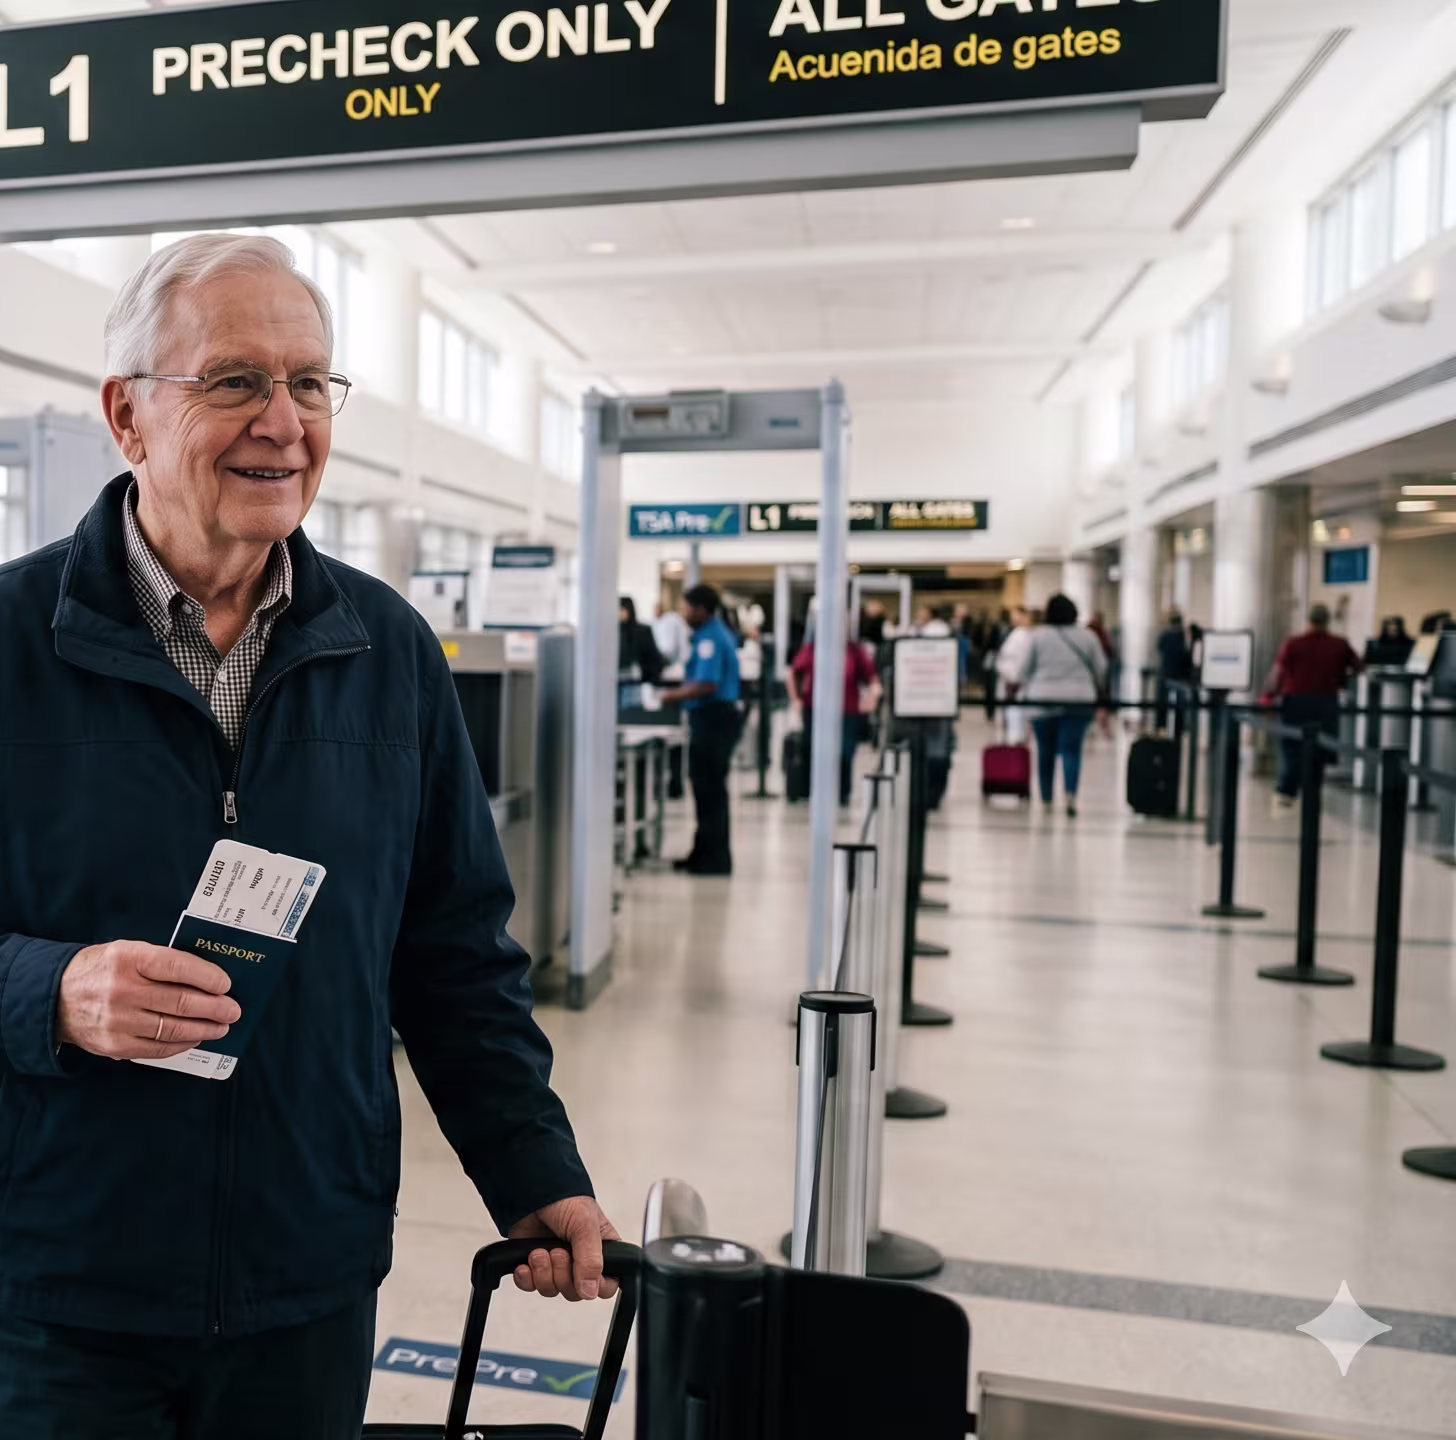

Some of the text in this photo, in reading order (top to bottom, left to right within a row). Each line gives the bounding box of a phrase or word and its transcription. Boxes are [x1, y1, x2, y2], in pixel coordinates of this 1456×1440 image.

[152, 0, 672, 95] PRECHECK ONLY
[768, 26, 1122, 83] Acuenida de gates
[345, 82, 441, 120] ONLY
[750, 504, 781, 531] L1
[195, 938, 266, 963] PASSPORT
